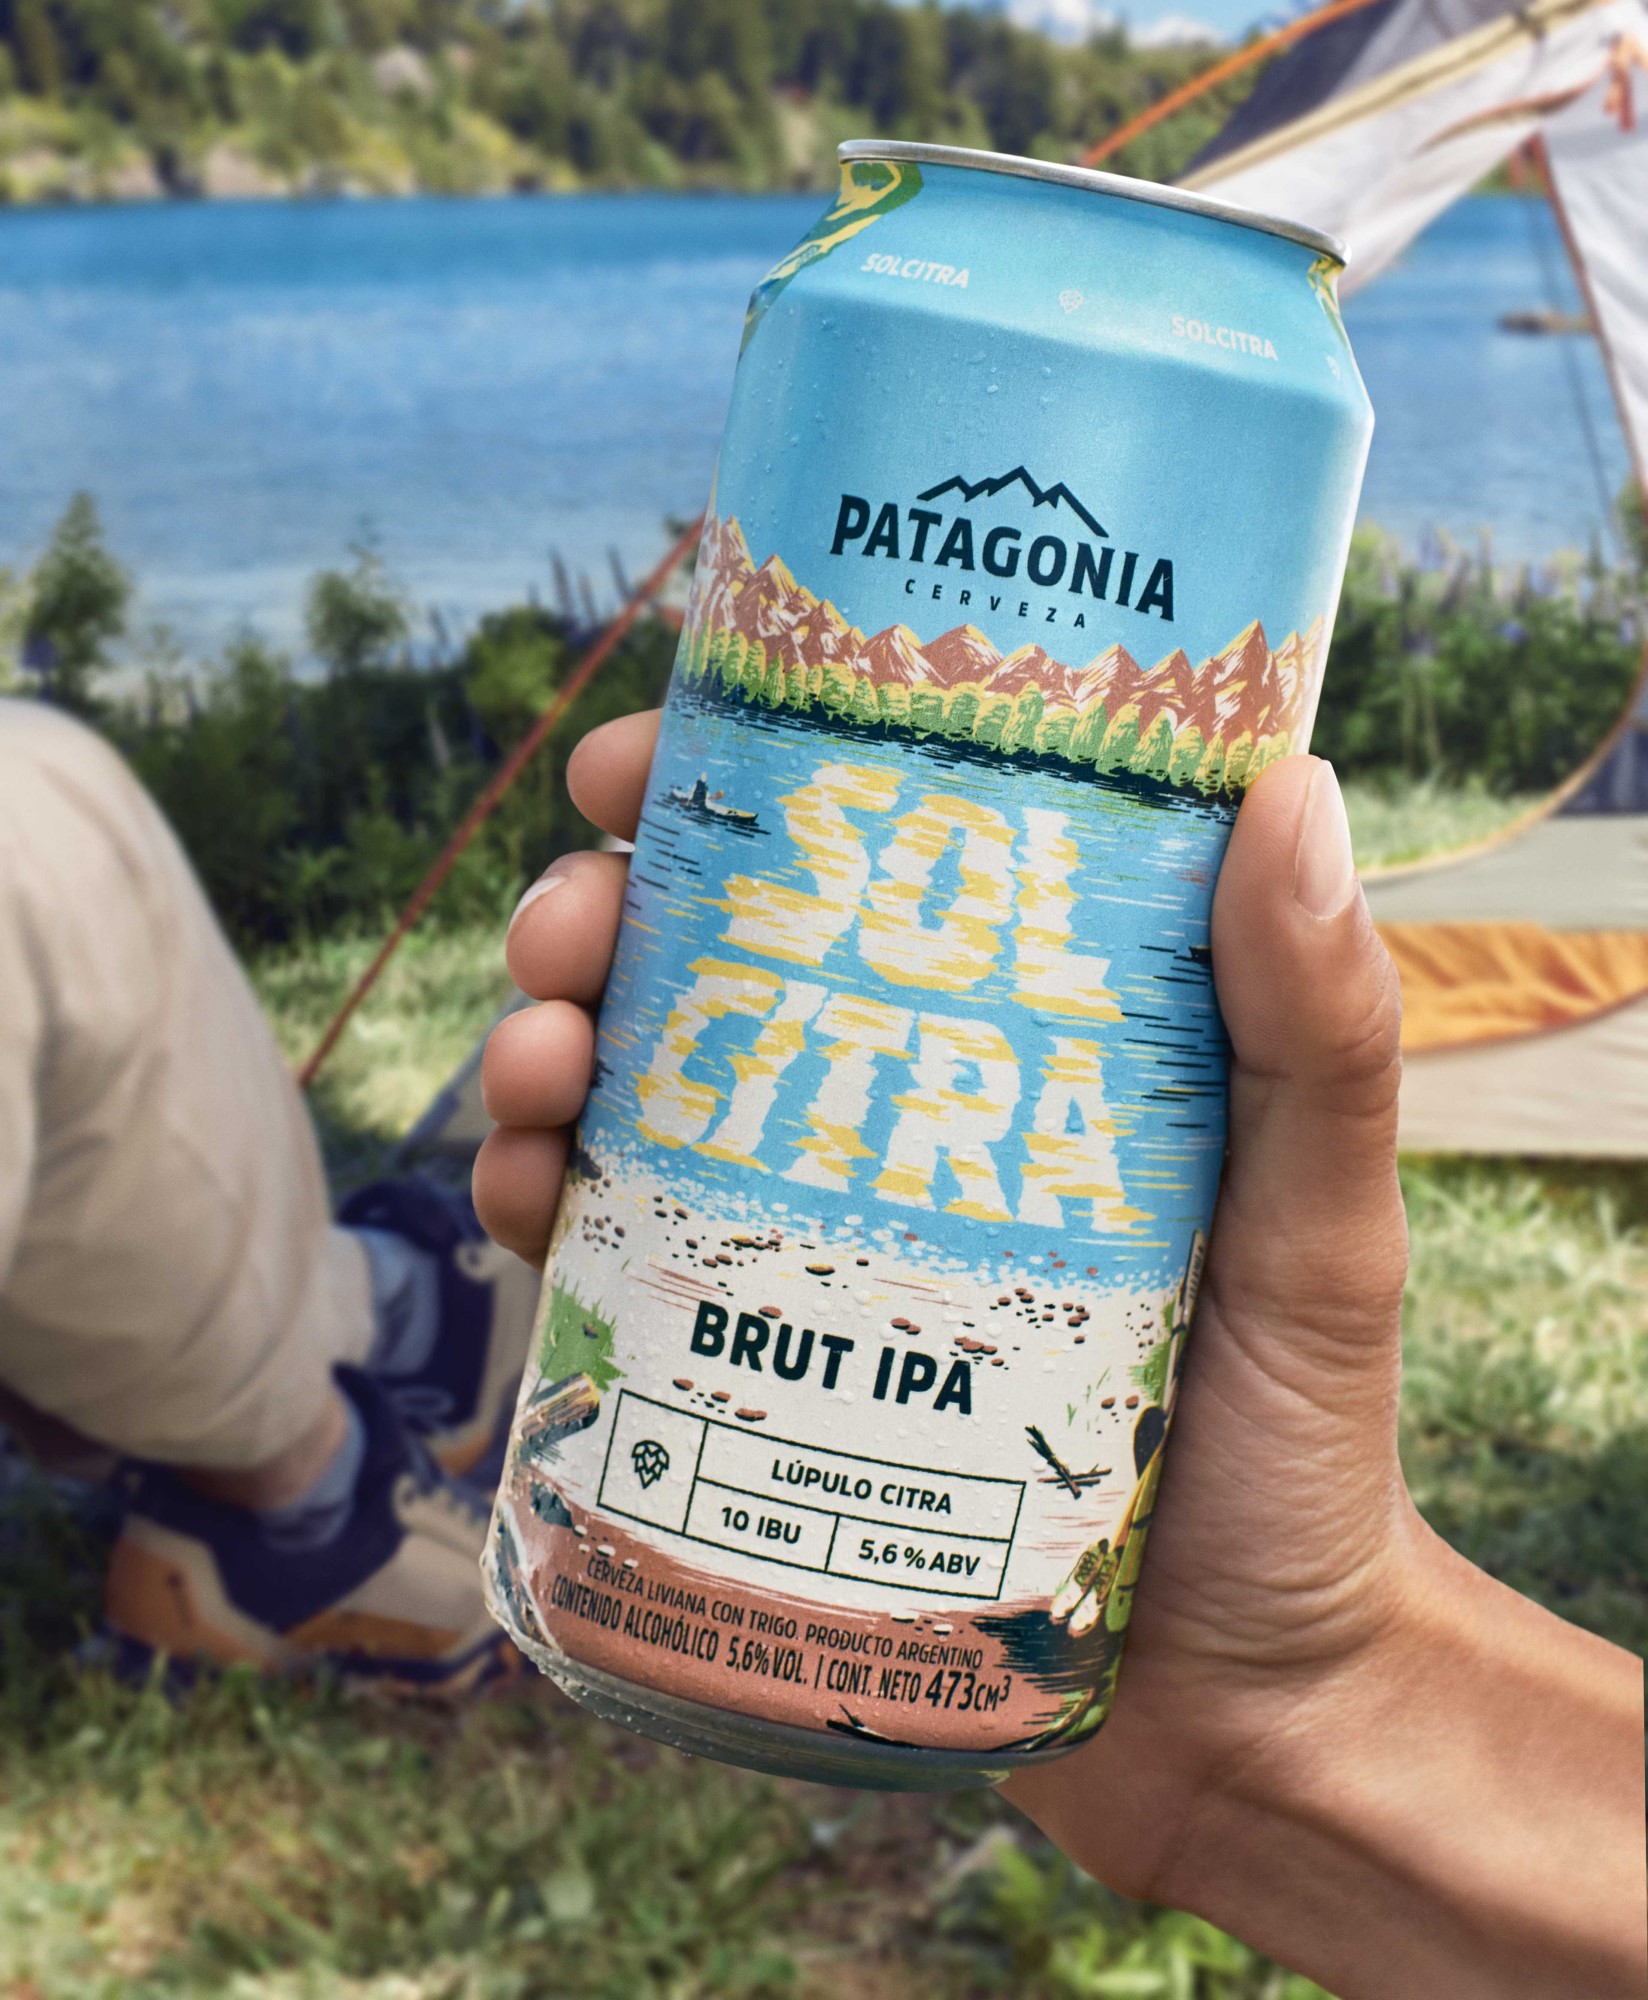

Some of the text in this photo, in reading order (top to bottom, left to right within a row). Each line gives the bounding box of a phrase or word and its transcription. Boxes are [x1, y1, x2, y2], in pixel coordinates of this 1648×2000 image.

[829, 494, 1175, 622] PATAGONIA
[904, 578, 1086, 629] CERVEZA
[717, 763, 1128, 1023] SOL
[631, 957, 1157, 1236] CITRA
[689, 1300, 972, 1416] BRUT IPA
[721, 1505, 802, 1545] 10 IBU
[770, 1458, 952, 1515] LÚPULO CITRA
[551, 1573, 623, 1631] CONTENIDO
[623, 1604, 720, 1663] ALCOHÓLICO
[826, 1658, 873, 1697] CONT.
[877, 1666, 922, 1704] NETO
[587, 1556, 644, 1597] CERVEZA
[647, 1579, 707, 1616] LIVIANA
[711, 1600, 745, 1626] CON
[804, 1623, 893, 1658] PRODUCTO
[896, 1641, 984, 1669] ARGENTINO
